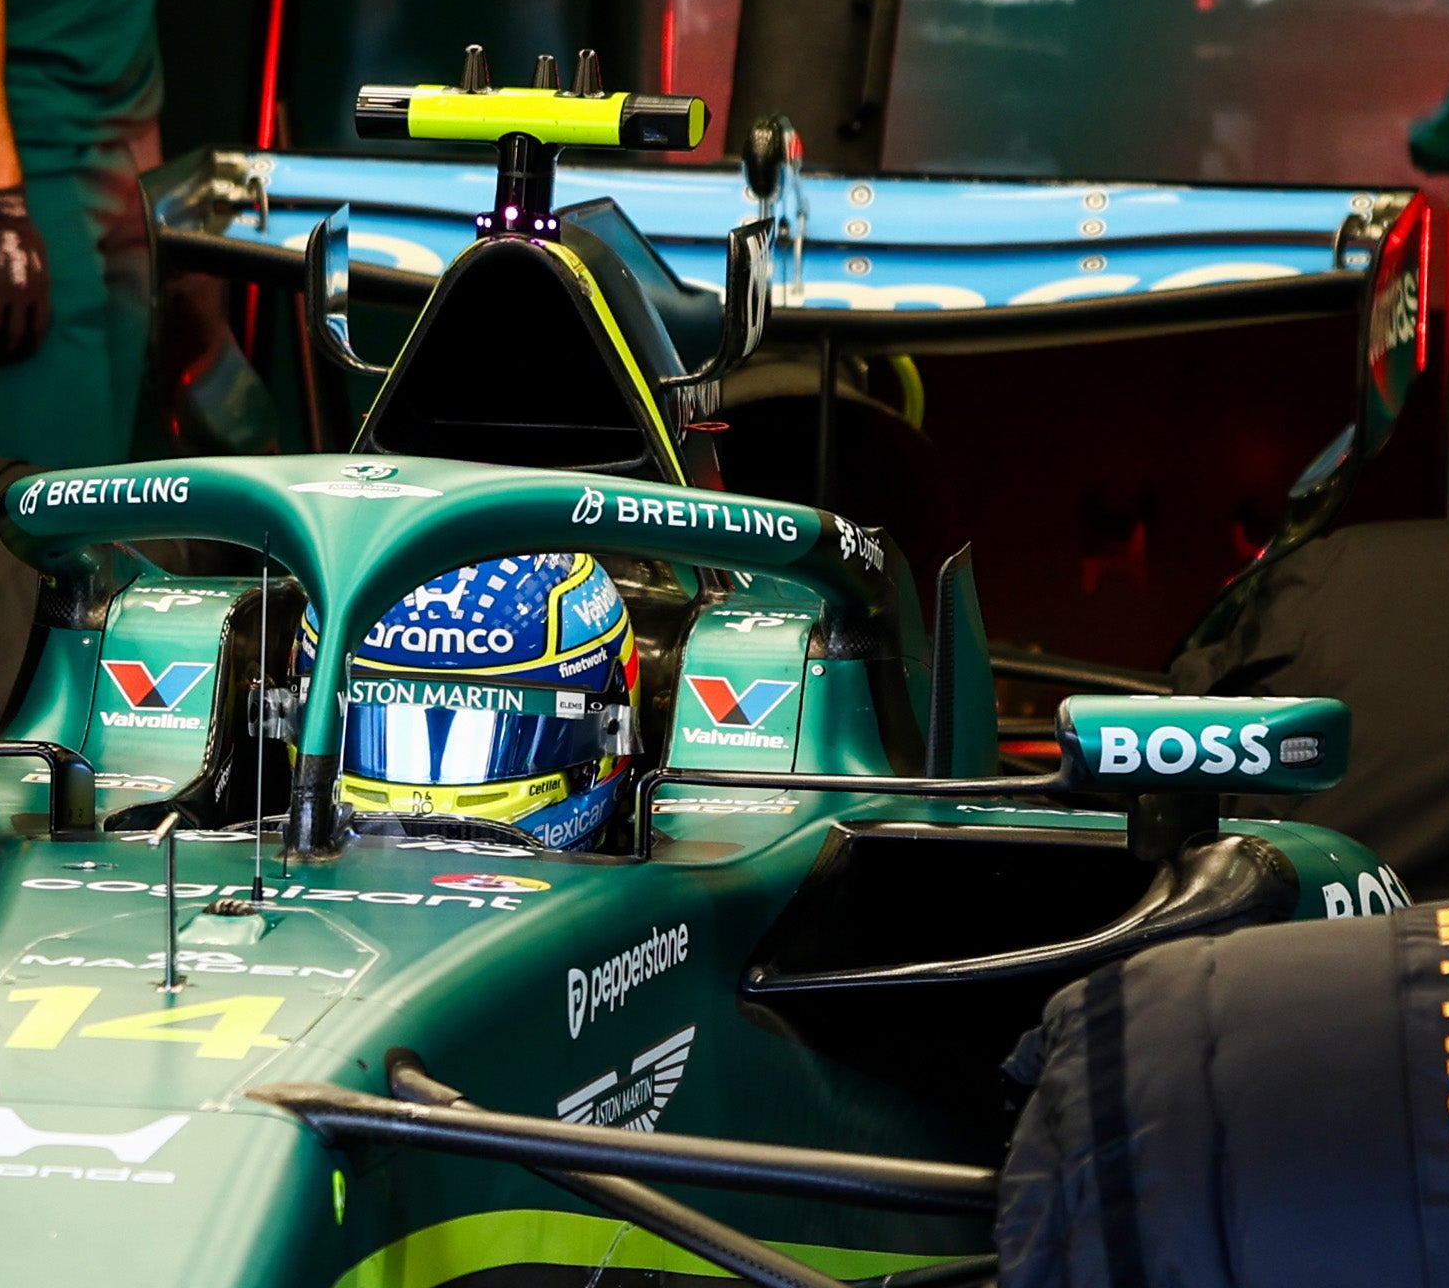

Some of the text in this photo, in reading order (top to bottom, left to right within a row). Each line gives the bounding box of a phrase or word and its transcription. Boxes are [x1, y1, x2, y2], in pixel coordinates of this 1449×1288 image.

[46, 476, 190, 507] BREITLING
[616, 495, 798, 542] BREITLING
[364, 621, 515, 655] aramco
[558, 648, 609, 678] finetwork
[422, 683, 524, 712] MARTIN
[559, 700, 583, 711] ELEMIS
[99, 712, 200, 729] Valvoline
[683, 727, 784, 748] Valvoline
[1098, 724, 1272, 776] BOSS
[528, 778, 563, 797] Cetilar
[20, 876, 523, 911] cognizant
[590, 921, 689, 1012] pepperstone
[4, 984, 294, 1061] 14
